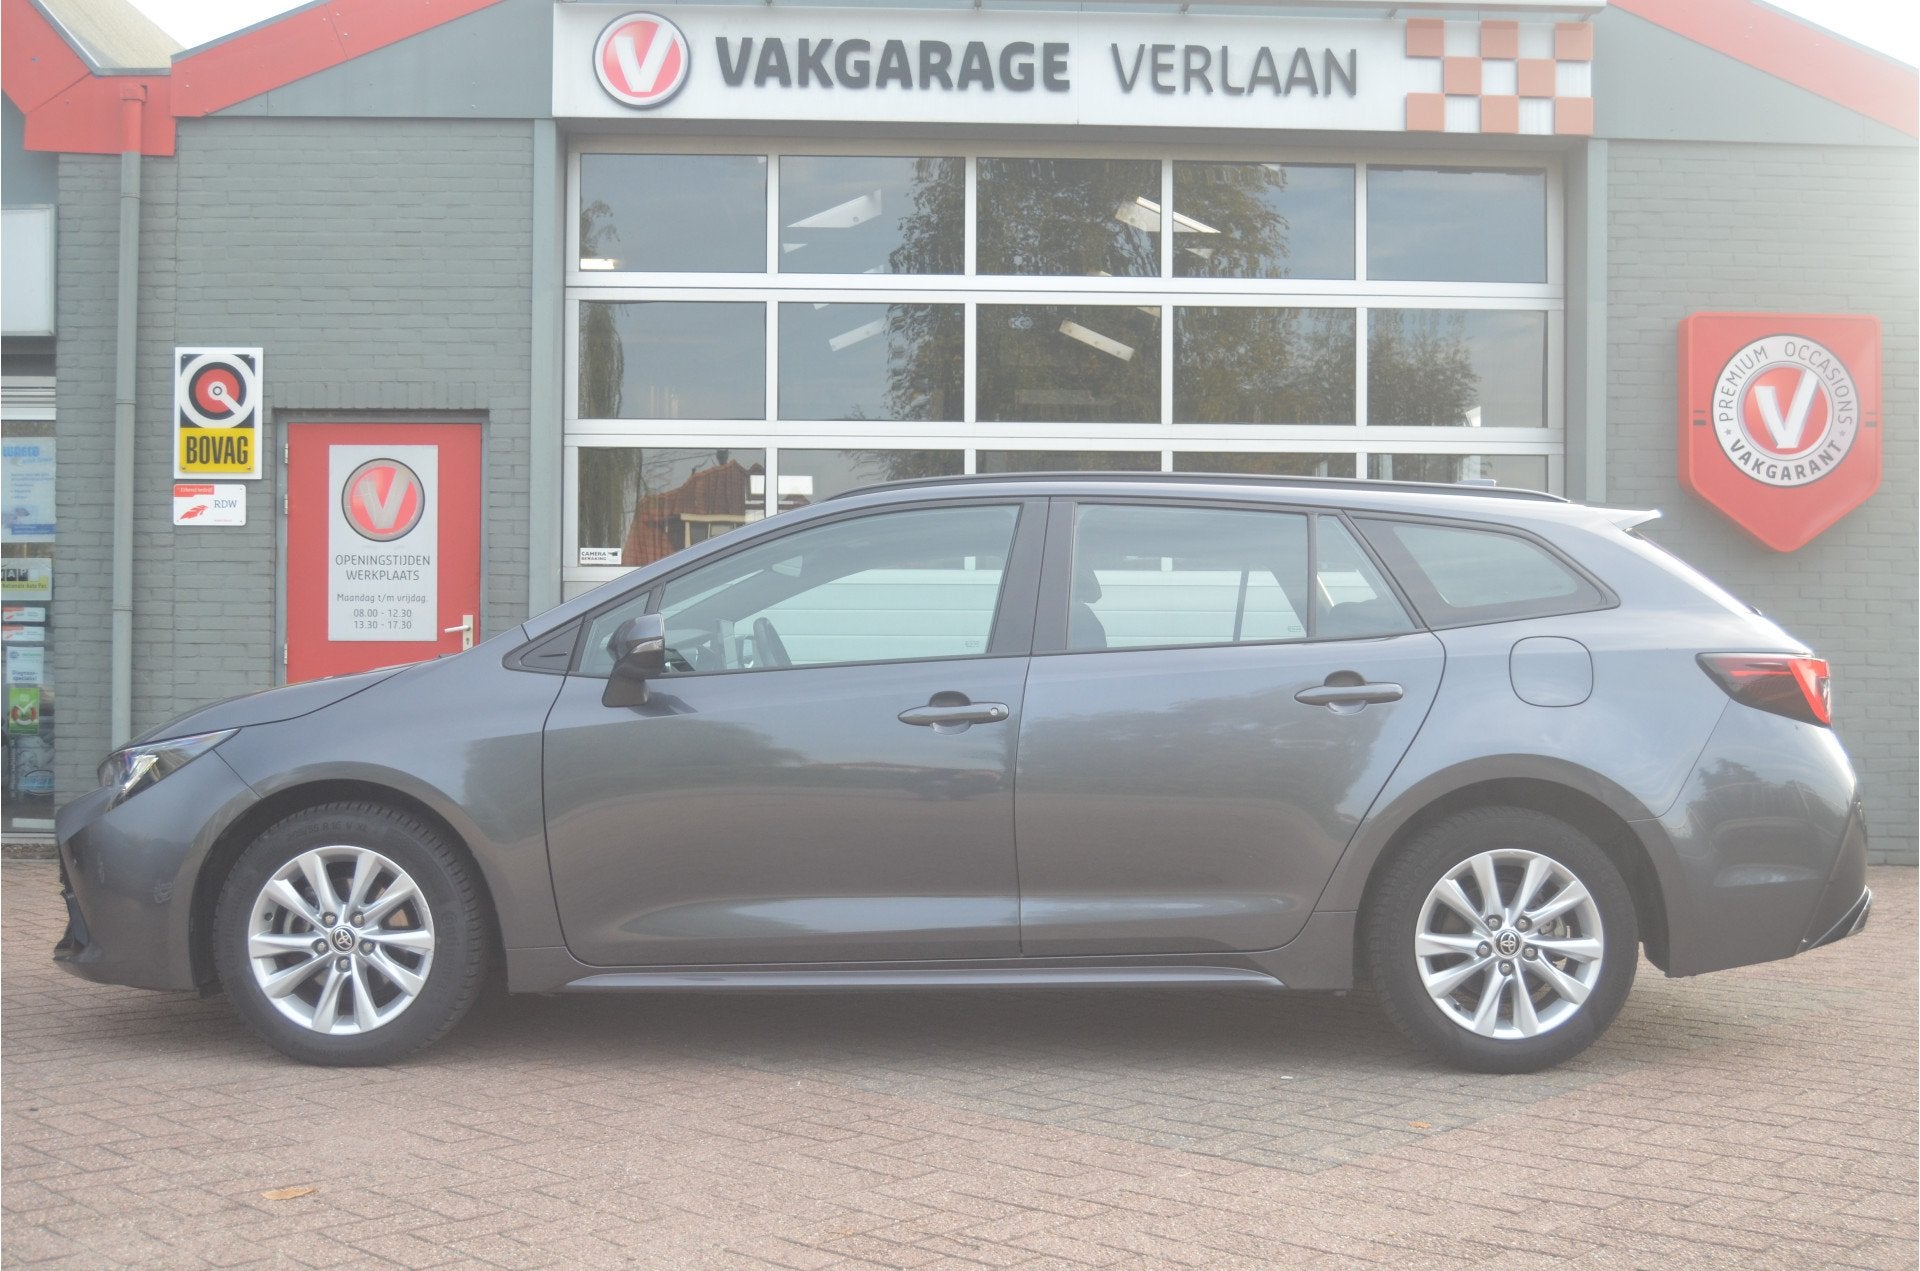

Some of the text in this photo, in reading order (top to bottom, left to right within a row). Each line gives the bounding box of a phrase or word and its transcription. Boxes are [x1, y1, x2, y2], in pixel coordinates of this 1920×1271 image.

[715, 36, 1357, 96] VAKGARAGE VERLAAN
[1719, 345, 1768, 422] PREMIUM
[1784, 341, 1853, 426] OCCASIONS
[186, 435, 249, 465] BOVAG
[1730, 438, 1843, 481] VAKGARANT
[214, 499, 237, 508] RDW
[335, 554, 430, 566] OPENINGSTIJDEN
[346, 570, 420, 580] WERKPLAATS
[337, 594, 426, 603] Maandag t/m vrijdag
[353, 609, 378, 617] 08.00
[388, 609, 412, 617] 12.30
[354, 621, 378, 629] 13.30
[388, 621, 412, 629] 17.30
